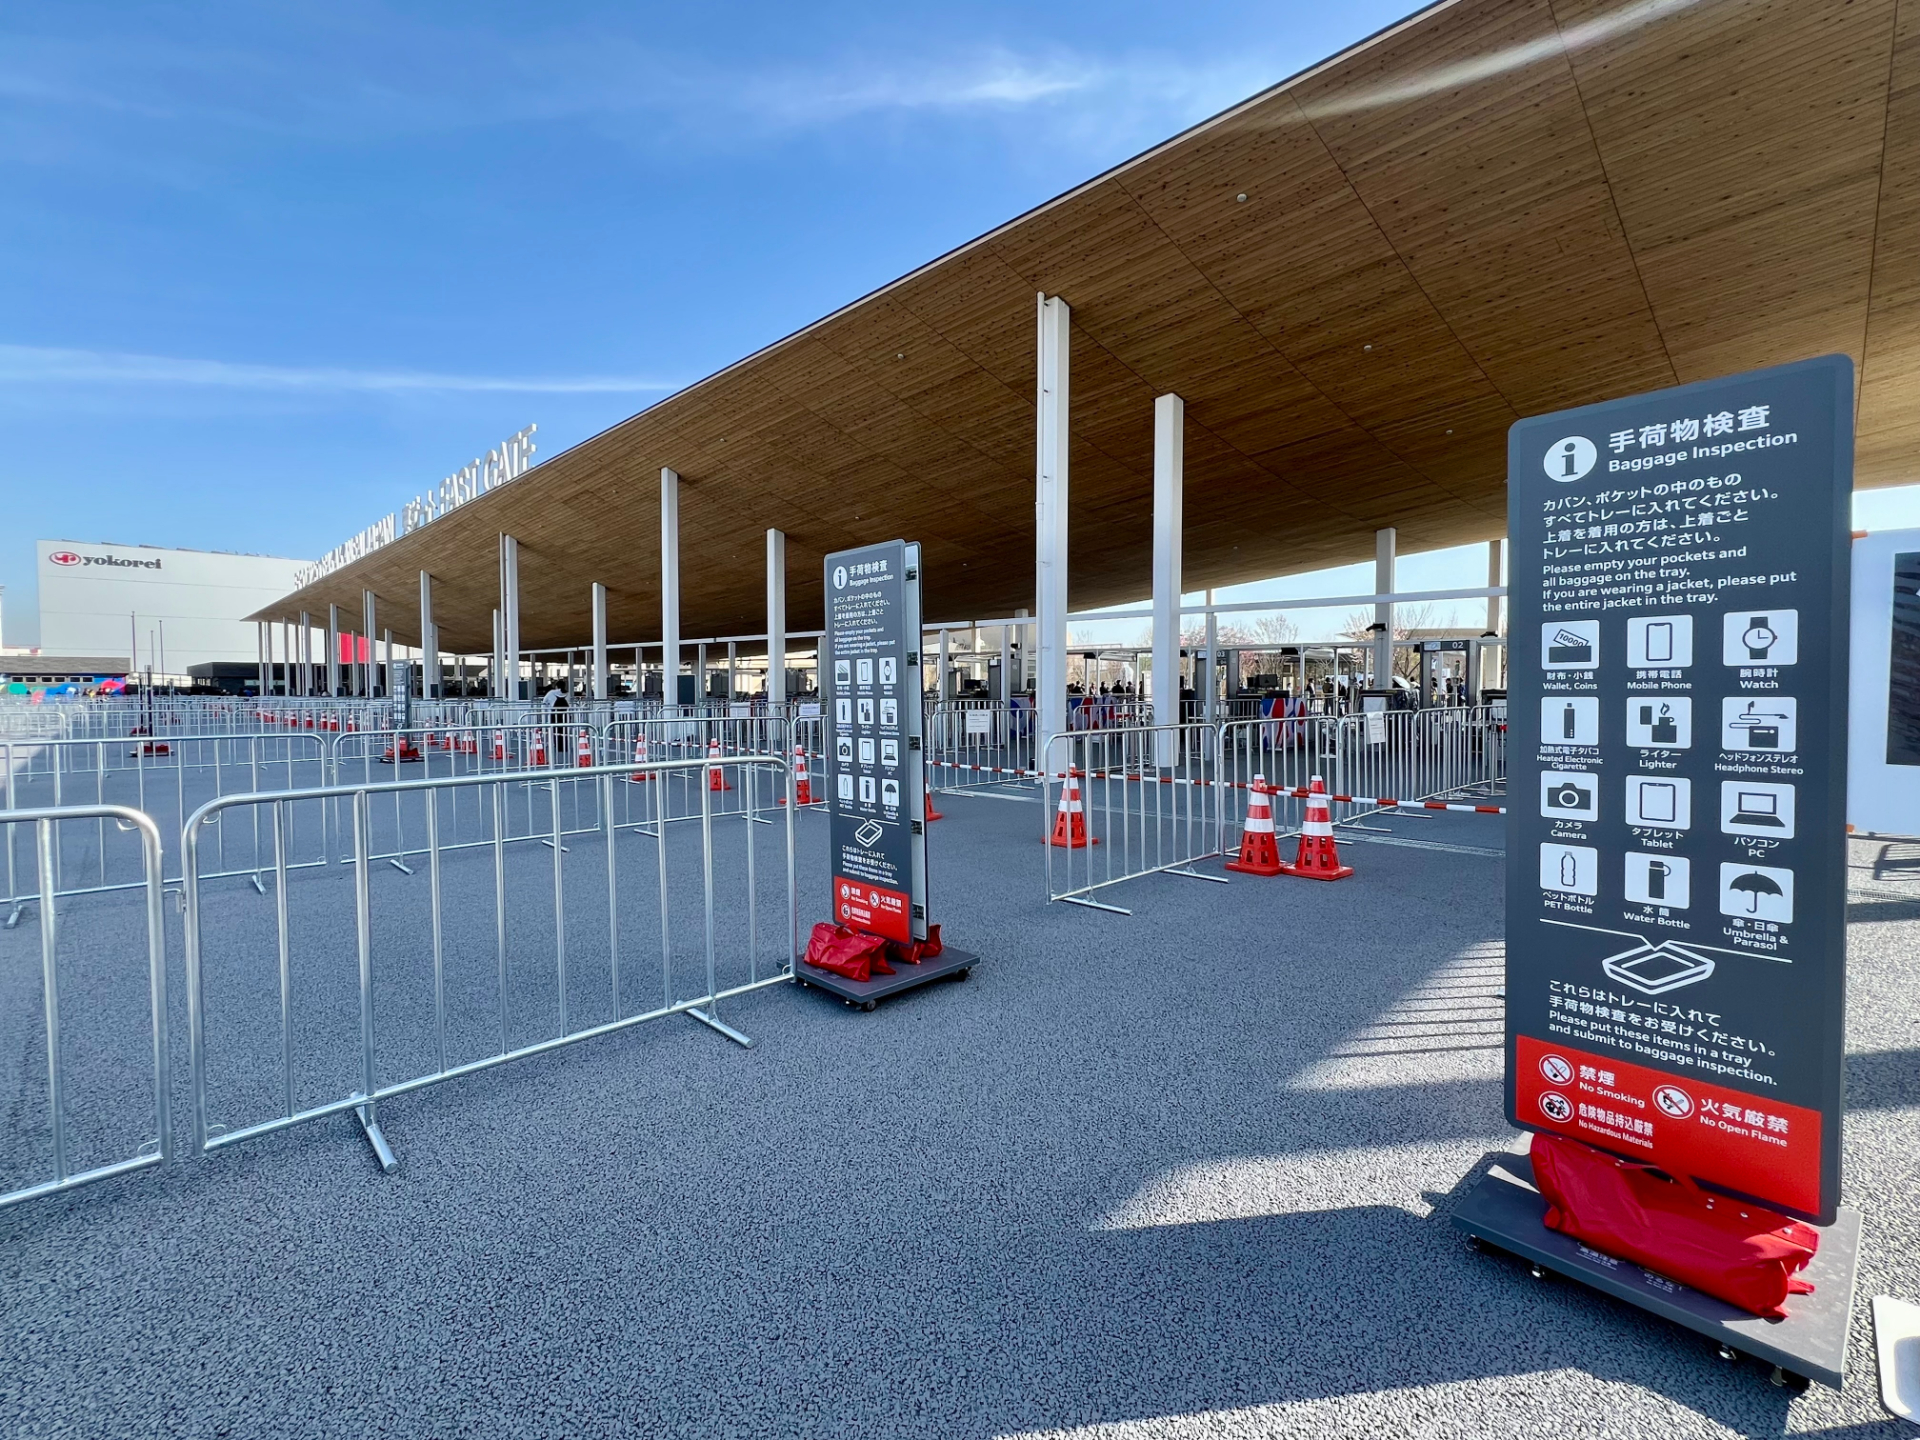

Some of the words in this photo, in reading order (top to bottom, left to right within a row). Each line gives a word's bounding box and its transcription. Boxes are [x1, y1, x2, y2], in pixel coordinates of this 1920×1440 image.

[1608, 405, 1770, 453] 手荷物検査
[1609, 452, 1687, 472] Baggage
[1693, 433, 1797, 458] Inspection
[440, 457, 481, 515] EAST
[484, 423, 538, 491] GATE
[1544, 474, 1741, 511] カバン、ポケットの中のもの
[1544, 488, 1778, 527] すべてトレーに入れてください。
[1543, 509, 1748, 543] 上着を着用の方は、上着ごと
[1544, 532, 1720, 559] トレーに入れてください。
[83, 555, 162, 569] yokorei
[1544, 565, 1581, 574] Please
[1584, 560, 1624, 571] empty
[1628, 557, 1657, 569] your
[1661, 551, 1715, 566] pockets
[1719, 547, 1746, 558] and
[1543, 577, 1556, 587] all
[1559, 575, 1612, 586] baggage
[1634, 570, 1656, 579] the
[1660, 568, 1690, 578] tray.
[1543, 590, 1551, 599] If
[1554, 591, 1574, 600] you
[1600, 584, 1652, 594] wearing
[1666, 578, 1713, 592] jacket,
[1718, 576, 1766, 589] please
[1770, 572, 1796, 585] put
[1543, 602, 1562, 611] the
[1565, 600, 1600, 610] entire
[1602, 597, 1642, 610] jacket
[1646, 596, 1656, 605] in
[1660, 594, 1683, 604] the
[1686, 594, 1718, 604] tray.
[1636, 670, 1682, 679] 携帯電話
[1740, 668, 1779, 678] 腕時計
[1543, 682, 1572, 690] Wallet,
[1574, 681, 1598, 689] Coins
[1627, 681, 1658, 689] Mobile
[1662, 681, 1692, 689] Phone
[1740, 681, 1779, 689] Watch
[1565, 756, 1603, 764] Electronic
[1640, 750, 1681, 758] ライター
[1719, 753, 1798, 764] ヘッドフォンステレオ
[1639, 760, 1677, 769] Lighter
[1714, 764, 1769, 774] Headphone
[1771, 766, 1803, 775] Stereo
[1554, 821, 1583, 830] カメラ
[1631, 827, 1684, 839] タブレット
[1551, 830, 1587, 840] Camera
[1734, 837, 1779, 848] パソコン
[1641, 839, 1673, 849] Tablet
[1748, 849, 1765, 858] PC
[1543, 891, 1595, 905] ペットボトル
[1544, 900, 1562, 910] PET
[1564, 903, 1593, 914] Bottle
[1624, 912, 1655, 925] Water
[1658, 917, 1691, 929] Bottle
[1723, 927, 1776, 943] Umbrella
[1779, 936, 1789, 945] &
[1733, 937, 1777, 951] Parasol
[1550, 980, 1721, 1026] これらはトレーに入れて
[1550, 995, 1775, 1056] 手荷物検査をお受けください。
[1550, 1010, 1587, 1027] Please
[1591, 1022, 1611, 1032] put
[1614, 1026, 1650, 1041] these
[1653, 1034, 1690, 1051] items
[1694, 1044, 1706, 1055] in
[1710, 1050, 1718, 1058] a
[1722, 1051, 1752, 1066] tray
[1549, 1024, 1570, 1034] and
[1574, 1030, 1616, 1046] submit
[1619, 1039, 1632, 1049] to
[1636, 1042, 1693, 1065] baggage
[1698, 1057, 1777, 1085] inspection.
[1580, 1065, 1615, 1086] 禁煙
[1580, 1082, 1594, 1092] No
[1597, 1086, 1645, 1108] Smoking
[1579, 1103, 1653, 1137] 危険物品持込厳禁
[1700, 1098, 1788, 1134] 火気厳禁
[1579, 1119, 1587, 1129] No
[1588, 1122, 1621, 1139] Hazardous
[1623, 1133, 1653, 1149] Materials
[1700, 1115, 1716, 1128] No
[1718, 1120, 1749, 1136] Open
[1751, 1129, 1788, 1147] Flame
